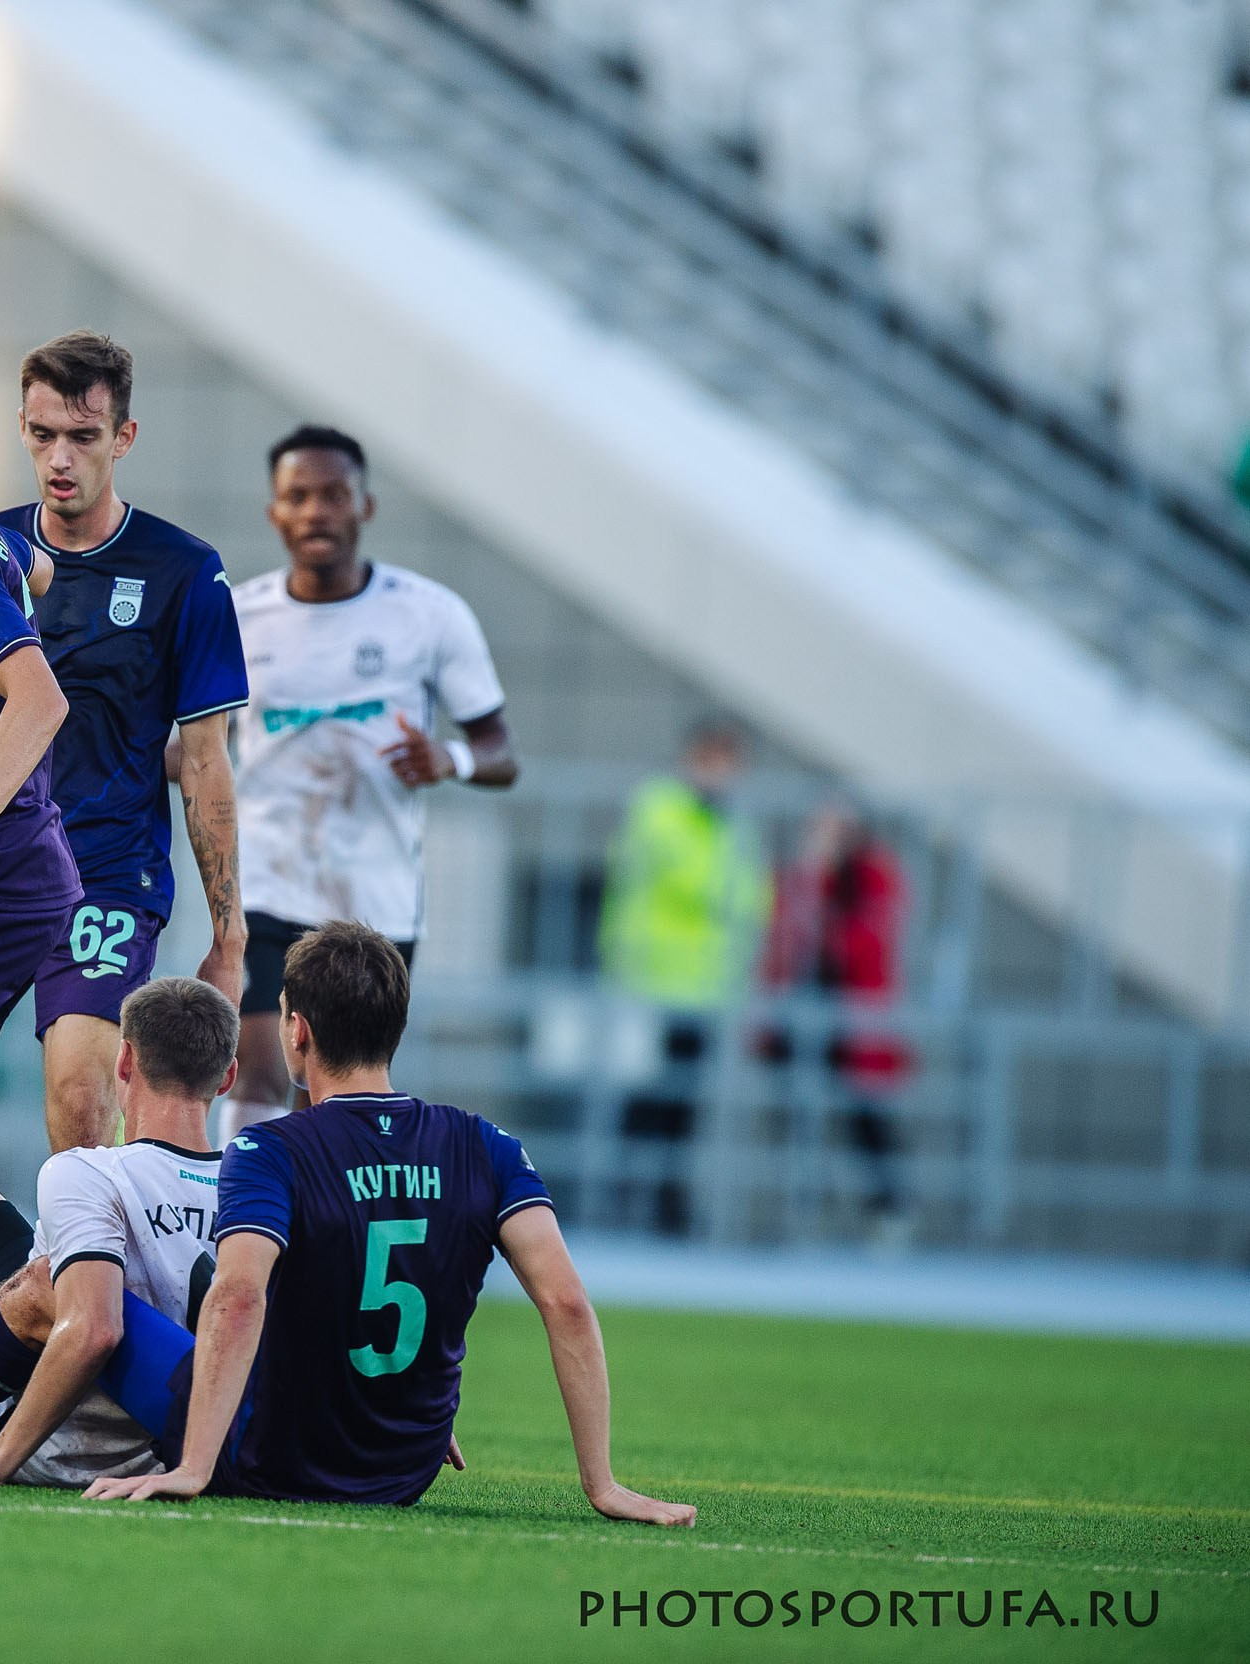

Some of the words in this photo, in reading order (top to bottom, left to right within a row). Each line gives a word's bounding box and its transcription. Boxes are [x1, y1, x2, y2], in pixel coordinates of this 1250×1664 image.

[69, 905, 136, 967] 62
[346, 1164, 442, 1202] КУТИН
[348, 1218, 429, 1378] 5
